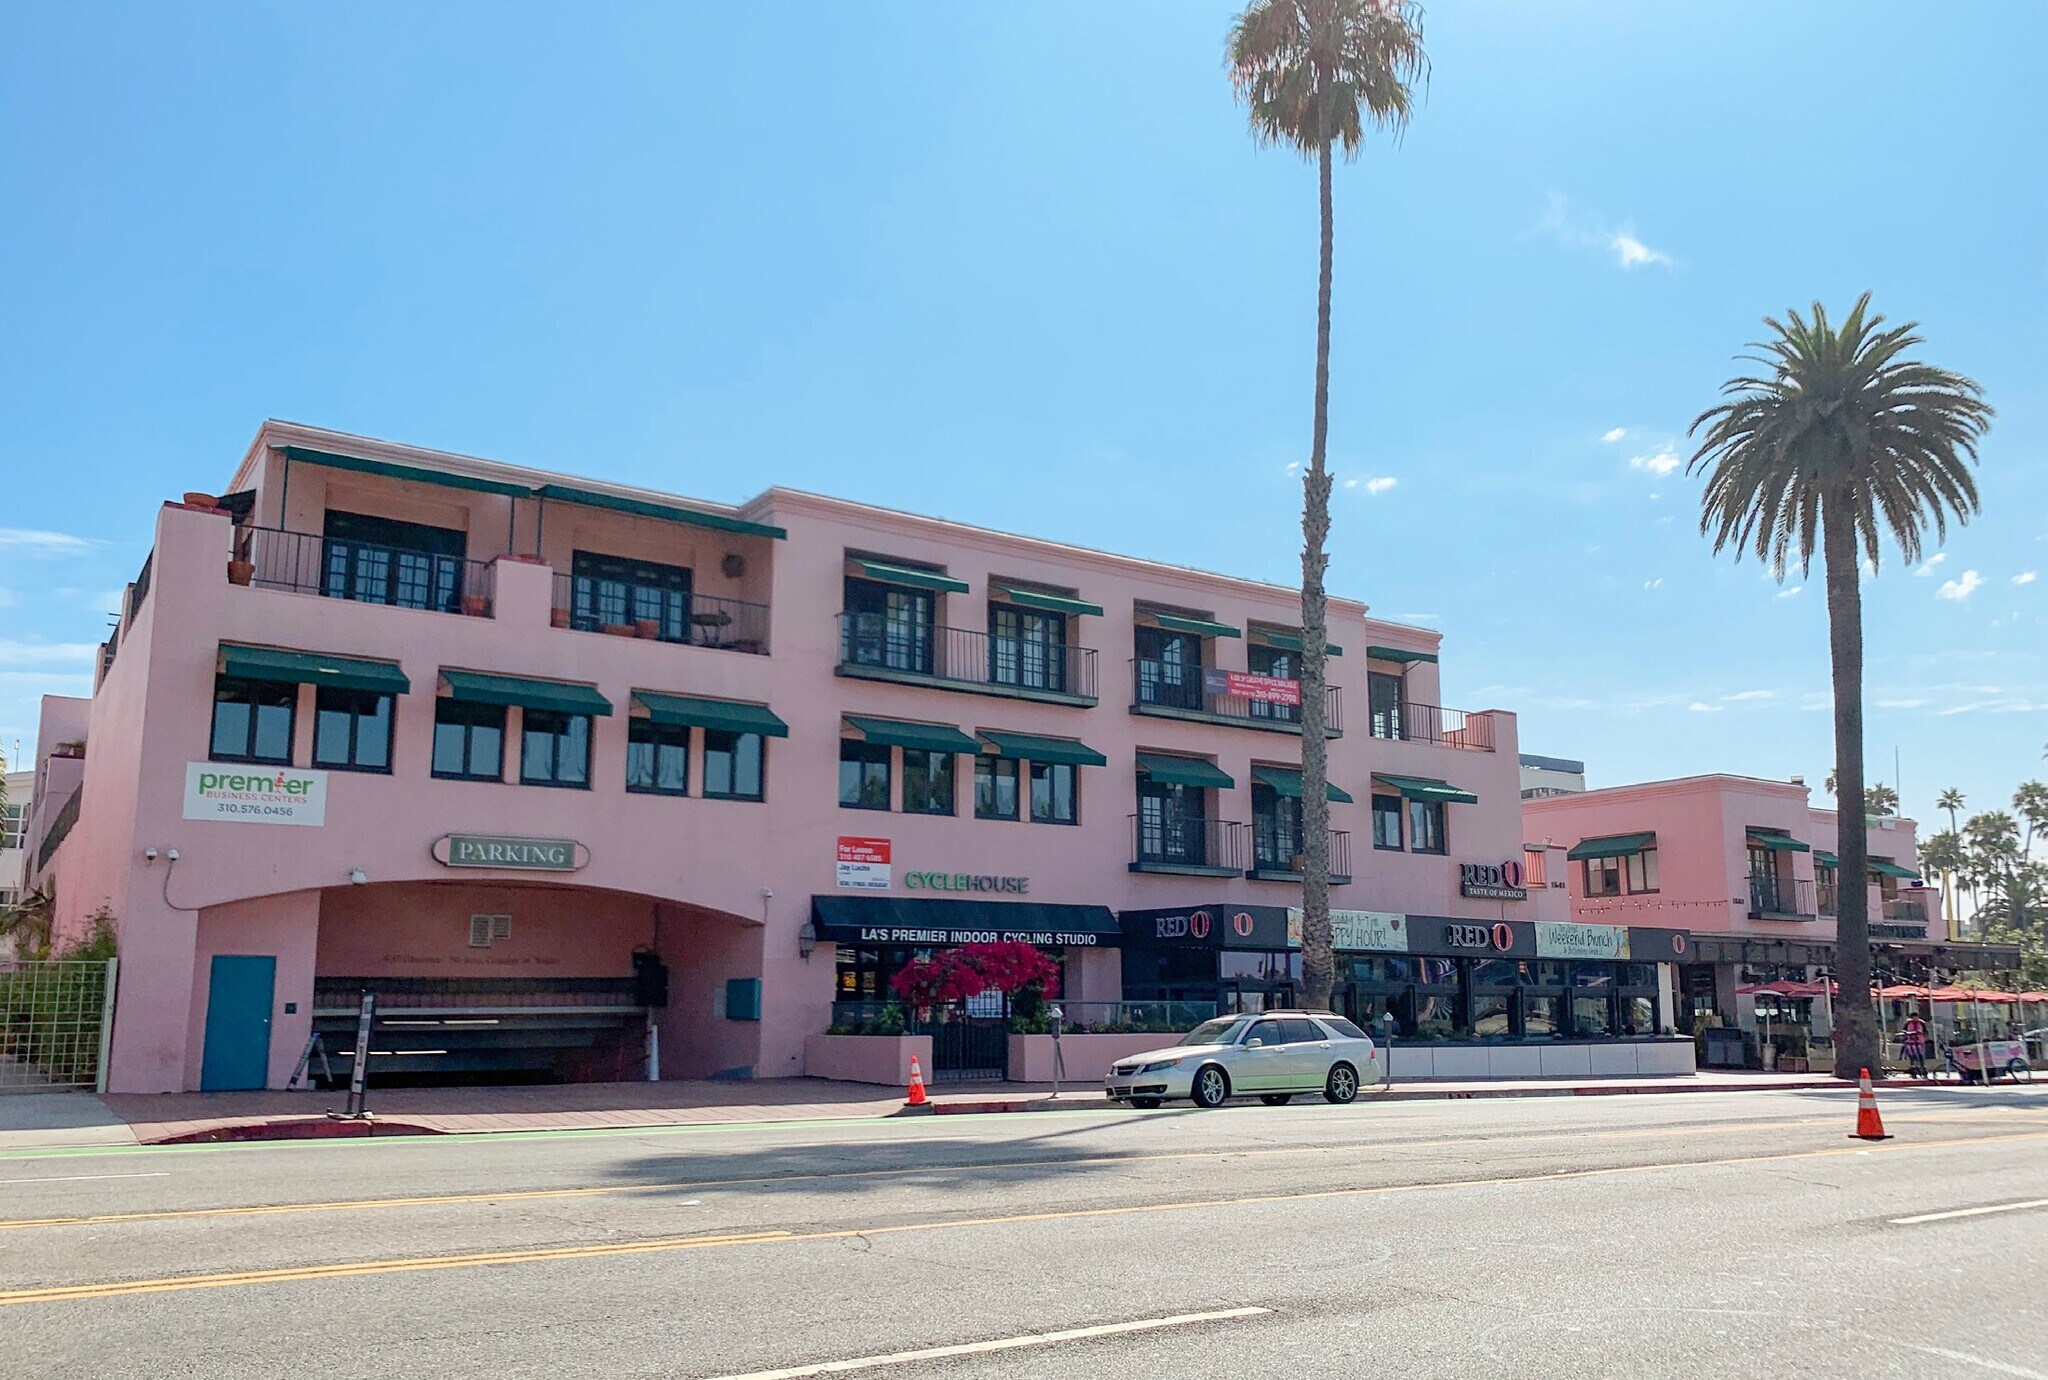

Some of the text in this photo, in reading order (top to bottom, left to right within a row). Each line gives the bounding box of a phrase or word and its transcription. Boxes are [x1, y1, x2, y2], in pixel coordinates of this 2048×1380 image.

[199, 771, 314, 795] premier
[206, 790, 307, 804] BUSINESS CENTERS
[217, 803, 294, 816] 310.576.0456
[460, 842, 565, 864] PARKING
[905, 871, 1030, 894] CYCLEHOUSE
[1461, 860, 1525, 889] RED O
[1469, 887, 1523, 898] TASTE OF MEXICO
[1156, 910, 1210, 939] RED O
[861, 928, 1097, 945] LA'S PREMIER INDOOR CYCLING STUDIO
[1356, 928, 1387, 948] HOUR!
[1450, 922, 1514, 952] RED O
[1548, 928, 1585, 946] Weekend
[1587, 929, 1613, 947] Brunch
